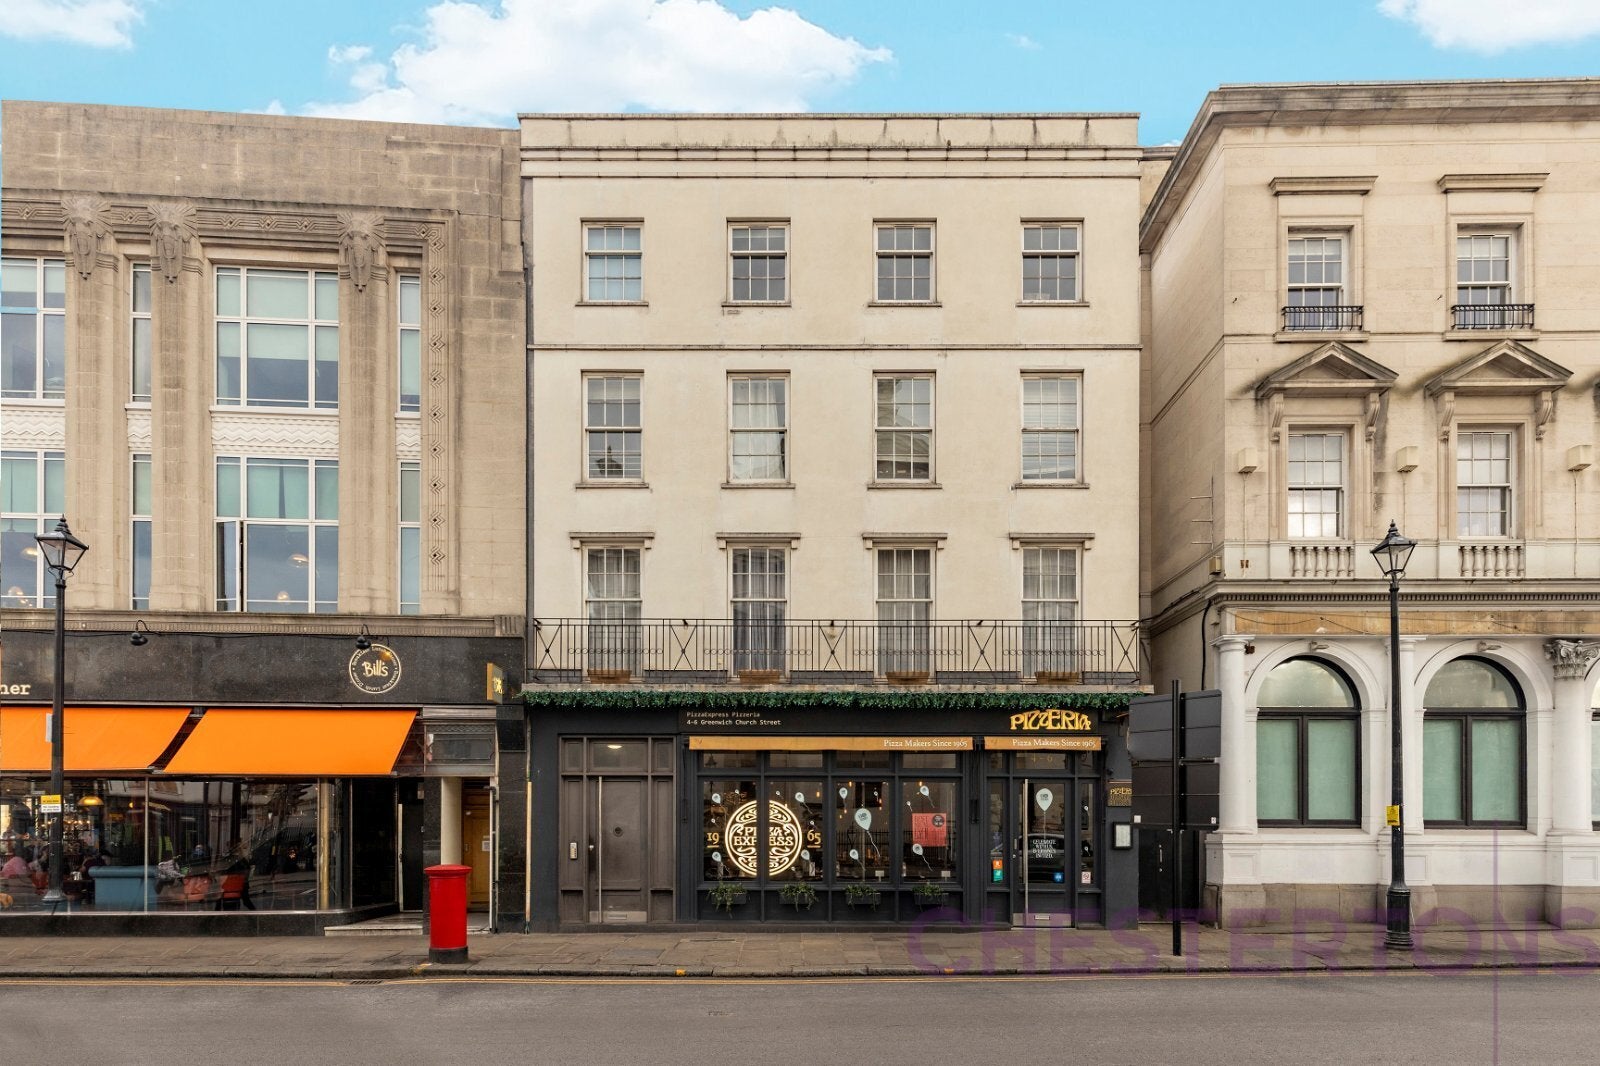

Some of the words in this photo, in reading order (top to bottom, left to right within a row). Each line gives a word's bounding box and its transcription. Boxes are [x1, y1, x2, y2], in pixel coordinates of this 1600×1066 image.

[361, 660, 389, 677] Bill's
[1009, 708, 1092, 730] PIZZERIA
[883, 739, 903, 747] Pizza
[904, 739, 931, 747] Makers
[932, 739, 952, 747] Since
[953, 739, 968, 748] 1965
[1012, 738, 1032, 746] Pizza
[1033, 738, 1060, 747] Makers
[1061, 738, 1081, 747] Since
[1082, 739, 1096, 748] 1965
[706, 832, 720, 844] 19
[807, 829, 821, 845] 65
[733, 836, 794, 846] EXPESS
